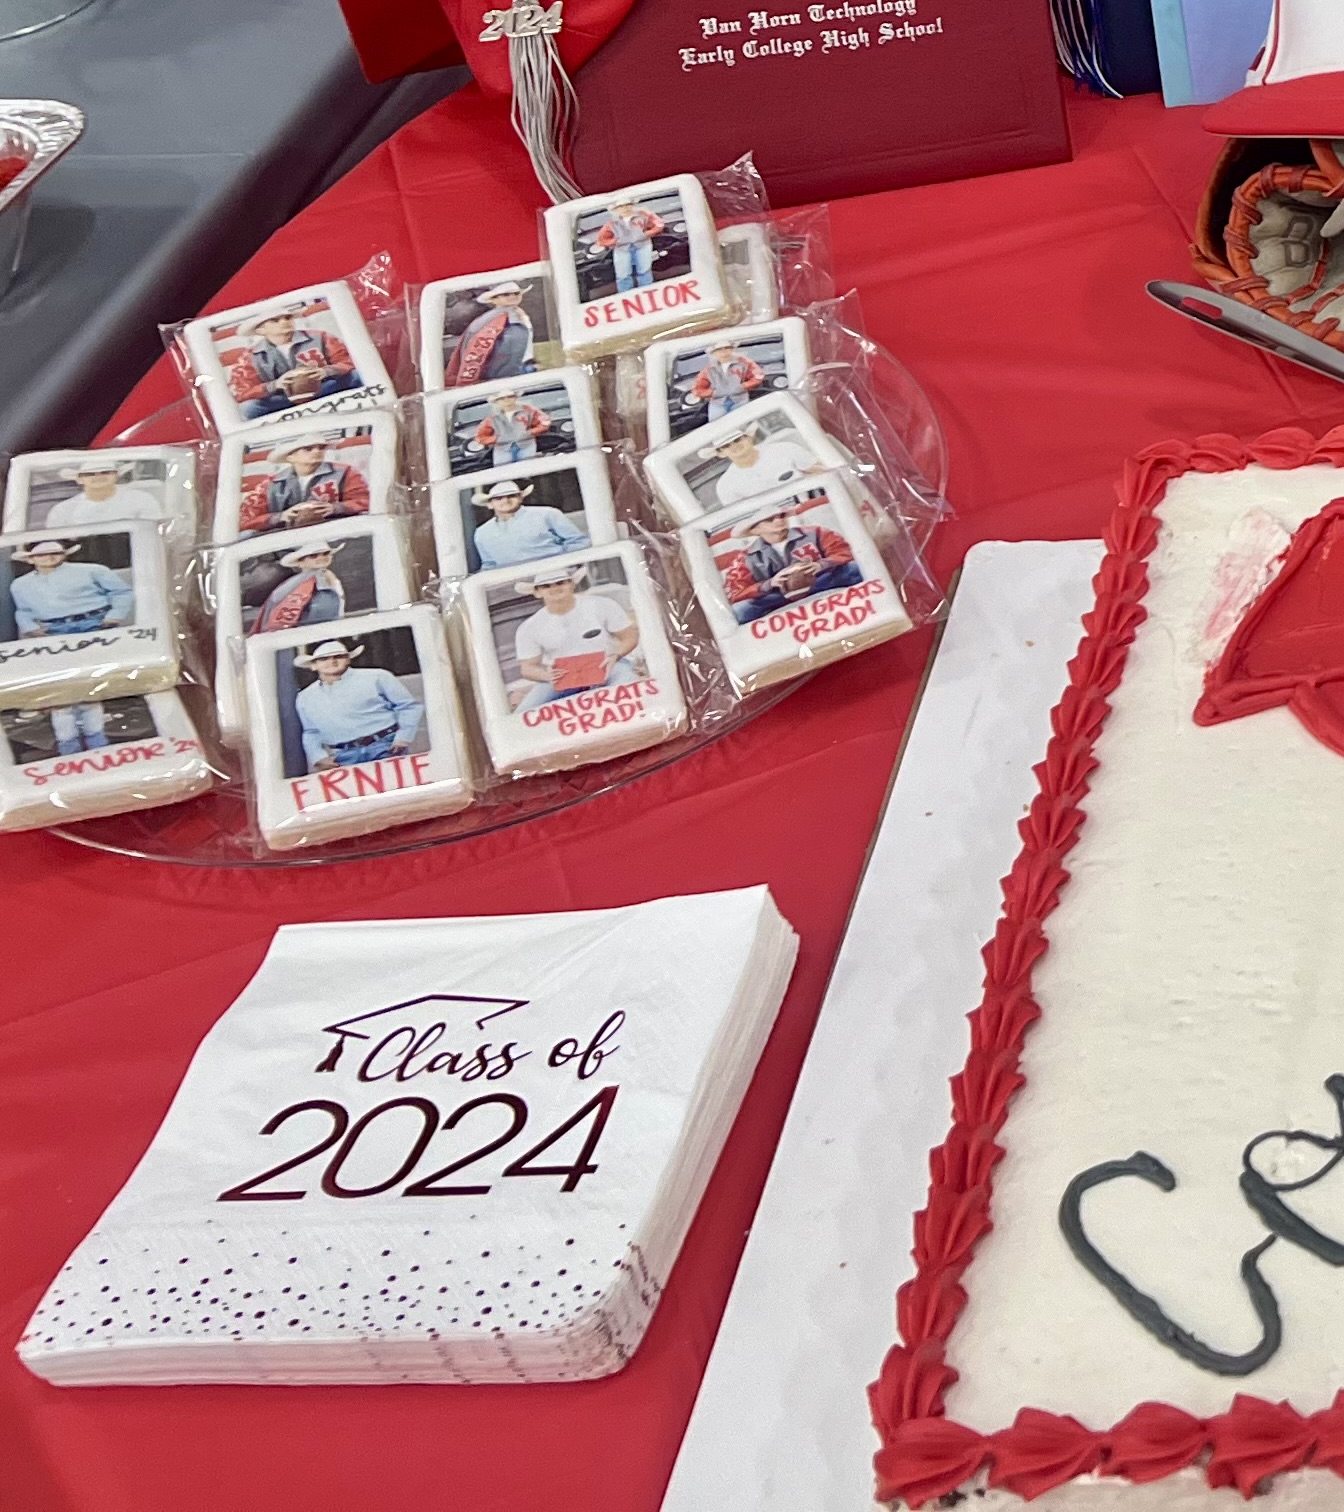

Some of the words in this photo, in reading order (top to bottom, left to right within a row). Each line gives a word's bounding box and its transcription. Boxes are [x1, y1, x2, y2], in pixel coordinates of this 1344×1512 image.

[678, 45, 736, 72] Early
[742, 38, 814, 59] College
[820, 27, 870, 55] High
[878, 17, 944, 46] School
[699, 17, 742, 40] Van
[748, 11, 802, 36] Horn
[583, 279, 703, 329] SENIOR
[750, 579, 886, 640] CONGRATS
[792, 599, 877, 644] GRAD!
[522, 678, 660, 728] CONGRATS
[557, 700, 647, 736] GRAD!
[356, 1022, 532, 1084] Class
[546, 1009, 628, 1081] of
[217, 1083, 622, 1204] 2024
